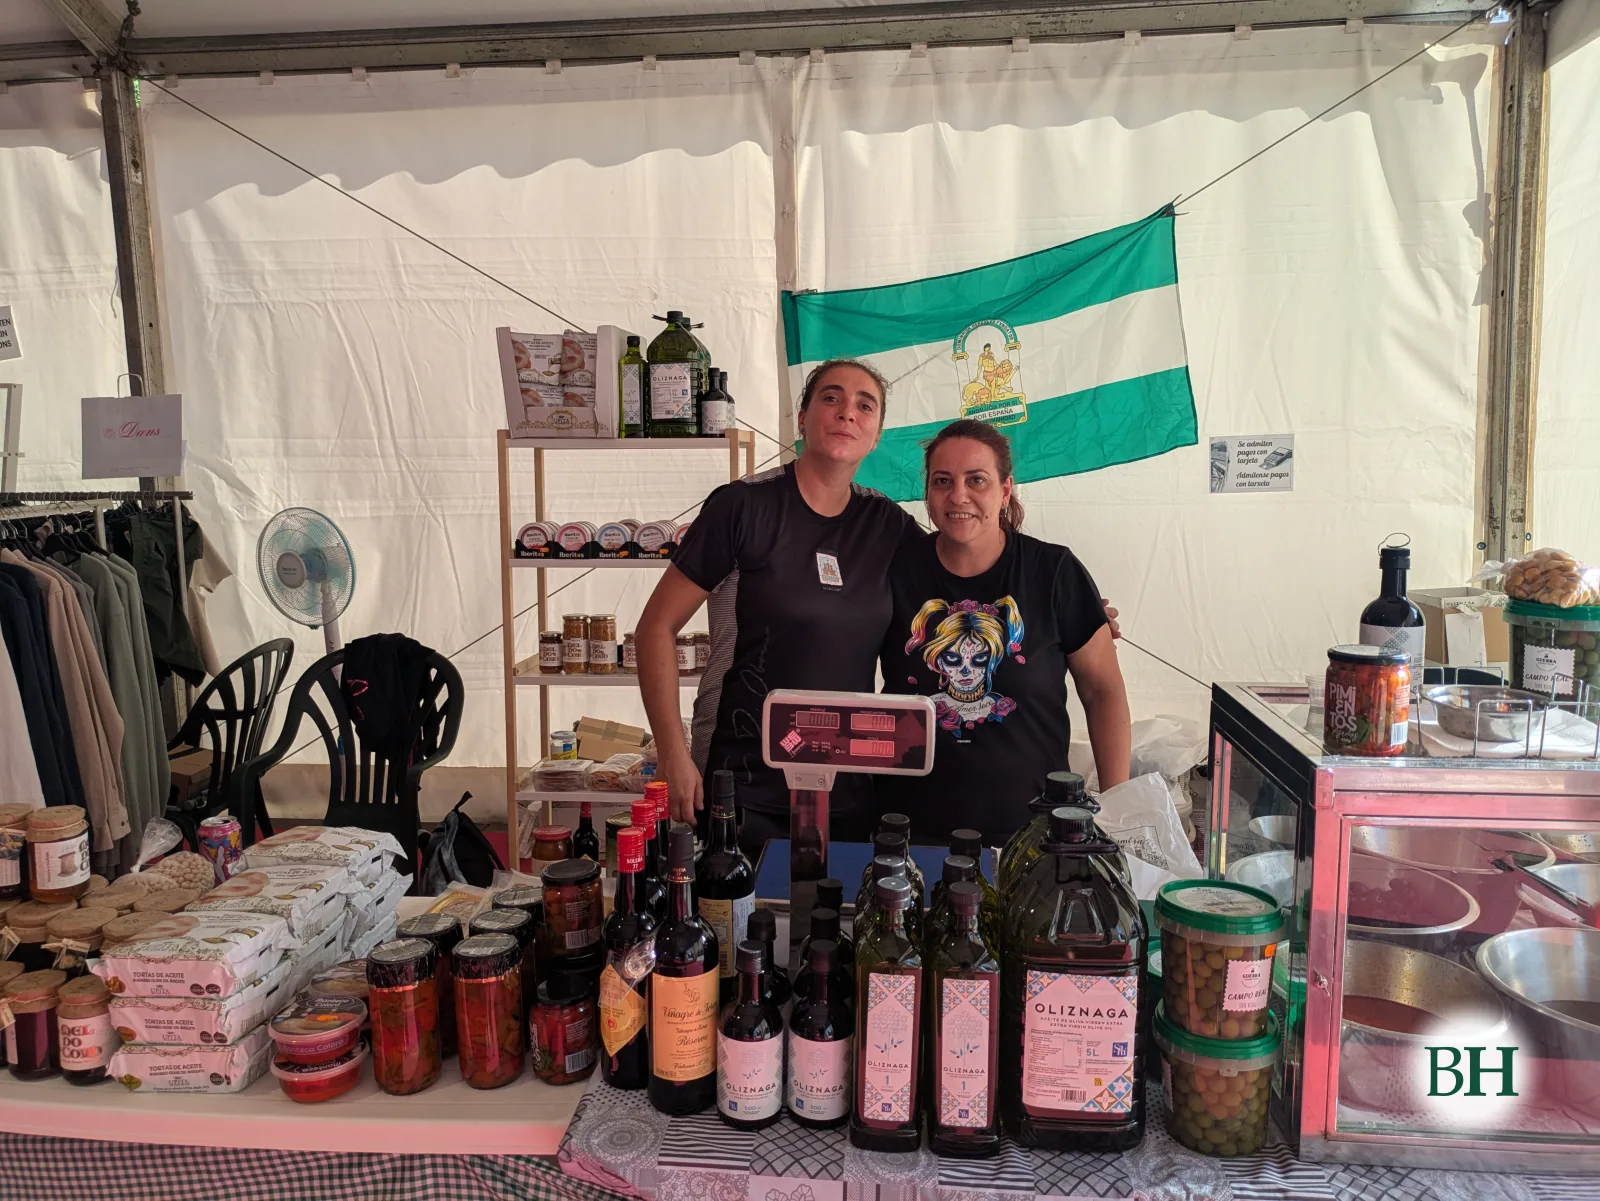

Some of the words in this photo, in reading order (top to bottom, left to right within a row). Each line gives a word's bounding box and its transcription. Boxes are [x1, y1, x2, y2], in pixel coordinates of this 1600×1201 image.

[999, 401, 1011, 409] POR
[988, 407, 1014, 418] ESPAÑA
[119, 421, 160, 438] Dans
[1525, 673, 1549, 681] CAMPO
[626, 857, 643, 865] SOLERA
[1227, 992, 1254, 1001] CAMPO
[662, 1005, 695, 1021] Vinagre
[1034, 1003, 1129, 1019] OLIZNAGA
[63, 1037, 82, 1048] DO
[1085, 1048, 1099, 1057] 5L
[867, 1060, 909, 1068] OLIZNAGA
[943, 1066, 986, 1074] OLIZNAGA
[885, 1074, 890, 1085] 1
[726, 1082, 777, 1094] OLIZNAGA
[793, 1079, 844, 1094] OLIZNAGA
[961, 1080, 966, 1091] 1
